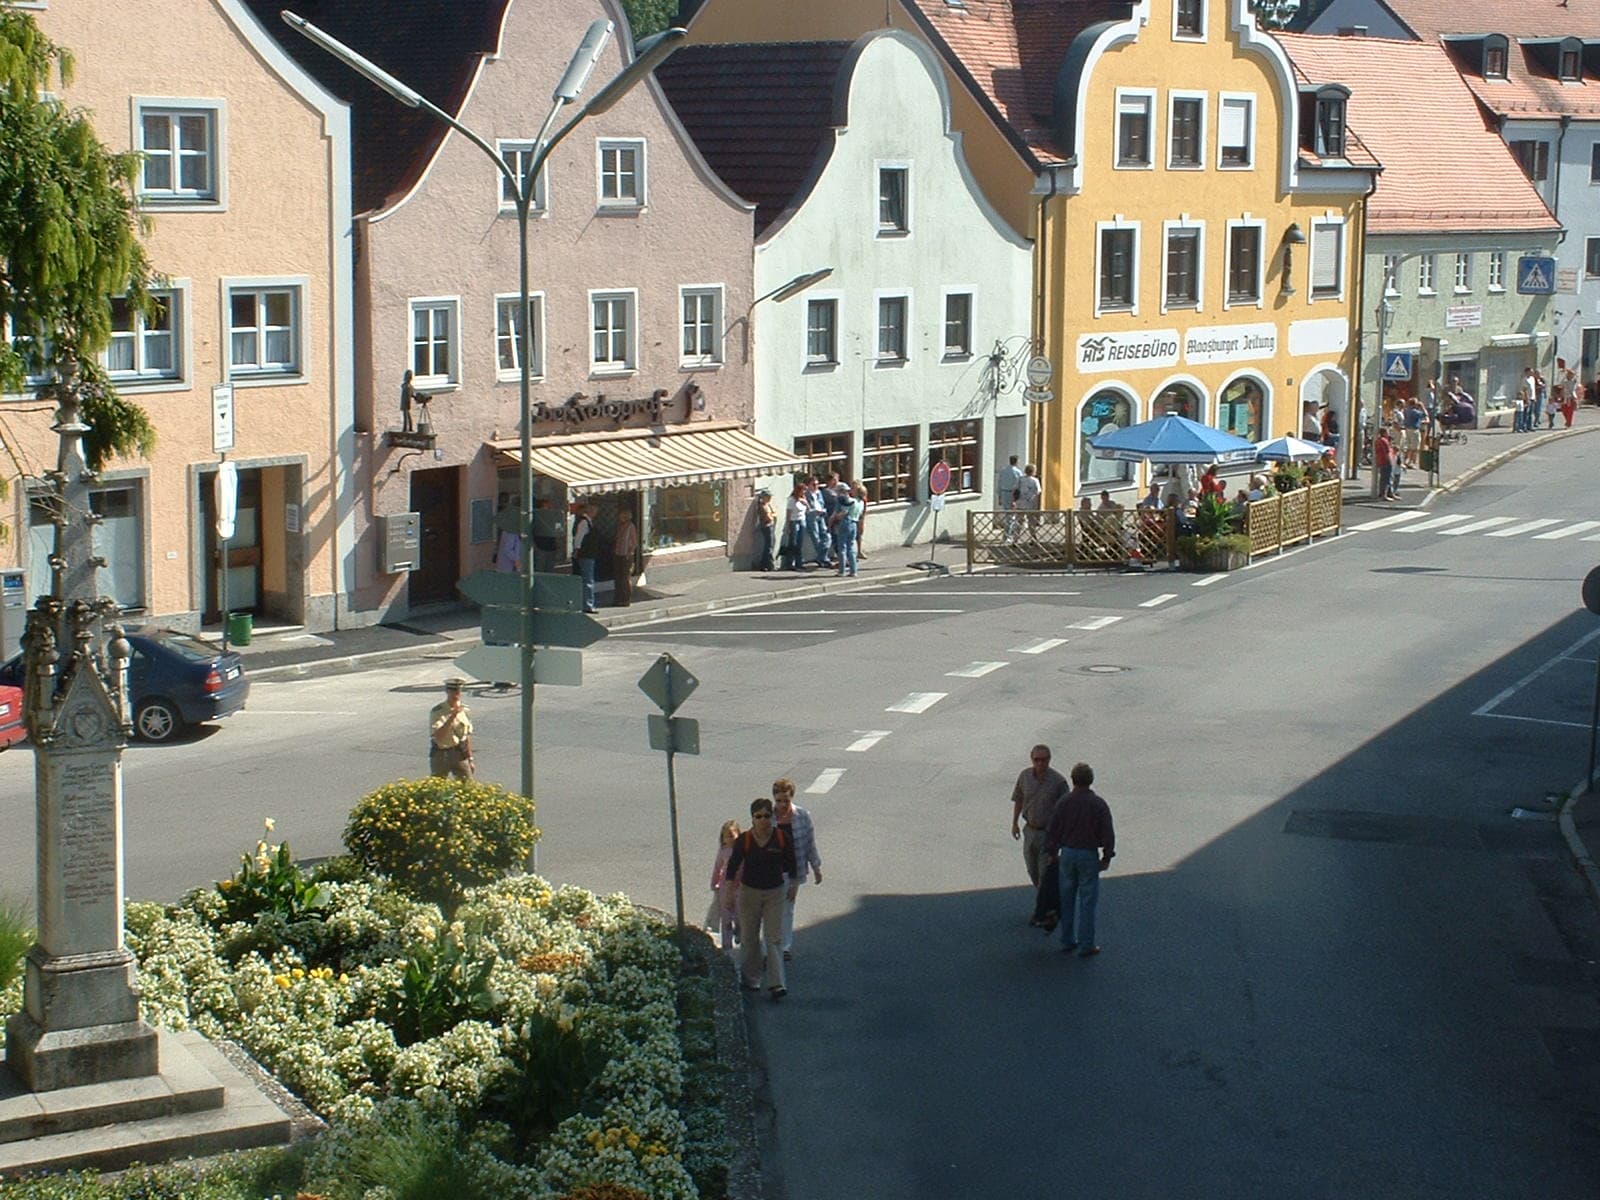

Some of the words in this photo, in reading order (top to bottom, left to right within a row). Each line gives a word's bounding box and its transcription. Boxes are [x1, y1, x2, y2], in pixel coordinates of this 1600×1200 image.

[1108, 339, 1177, 361] REISEBÜRO
[1186, 338, 1239, 355] Moosburger
[1243, 335, 1275, 352] Zeitung
